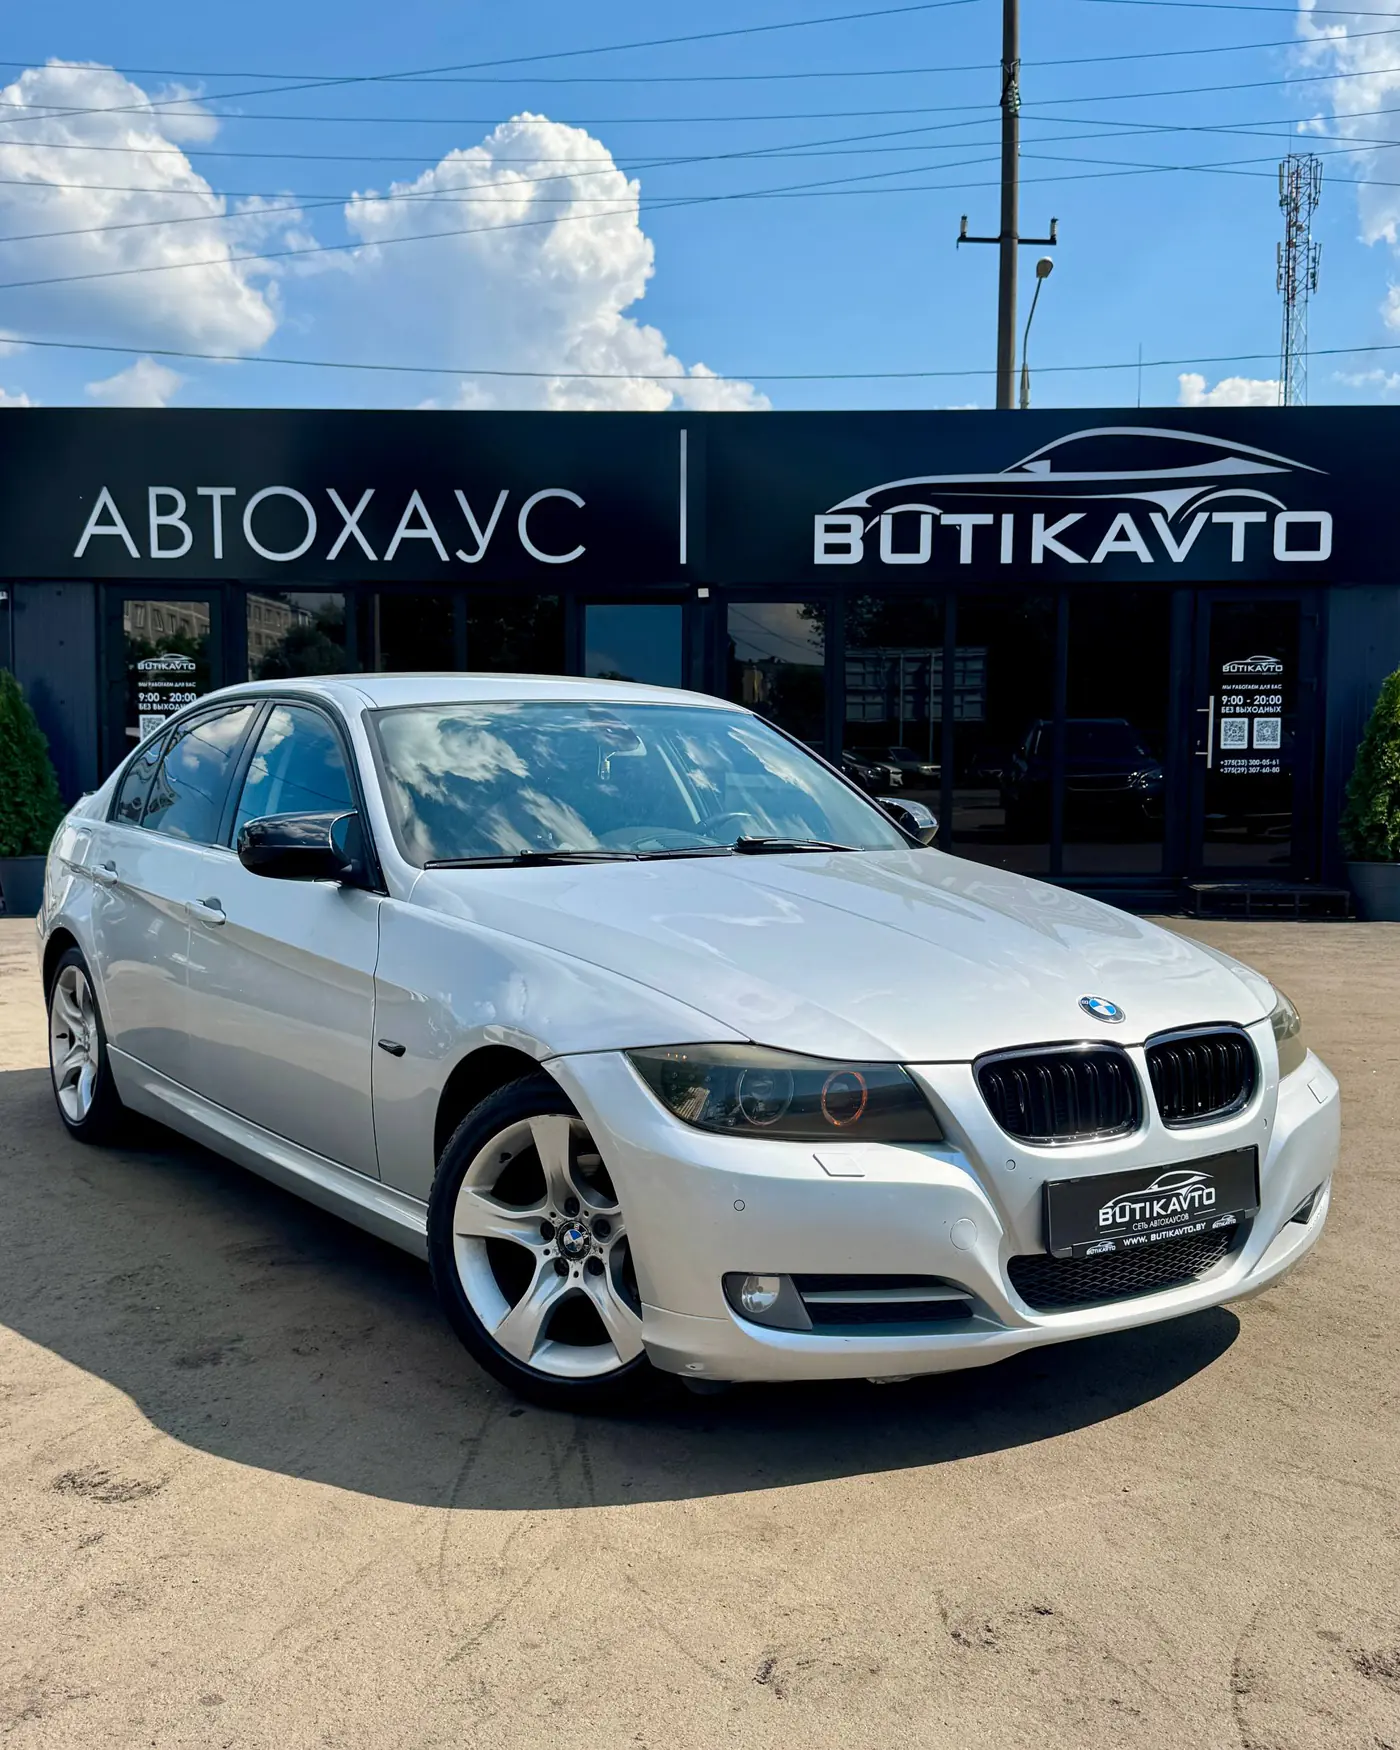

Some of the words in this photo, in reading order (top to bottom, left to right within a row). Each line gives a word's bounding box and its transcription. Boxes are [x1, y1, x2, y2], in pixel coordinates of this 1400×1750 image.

[73, 485, 587, 564] АВТОХАУС
[813, 510, 1334, 565] BUTIKAVTO
[138, 692, 160, 702] 9:00
[169, 692, 197, 702] 20:00
[1222, 695, 1244, 705] 9:00
[1253, 695, 1282, 704] 20:00
[1235, 706, 1282, 714] ВЫХОДНЫХ
[1098, 1187, 1216, 1226] BUTIKAVTO
[1132, 1221, 1149, 1231] СЕТЬ
[1149, 1213, 1190, 1228] АВТОХАУСОВ
